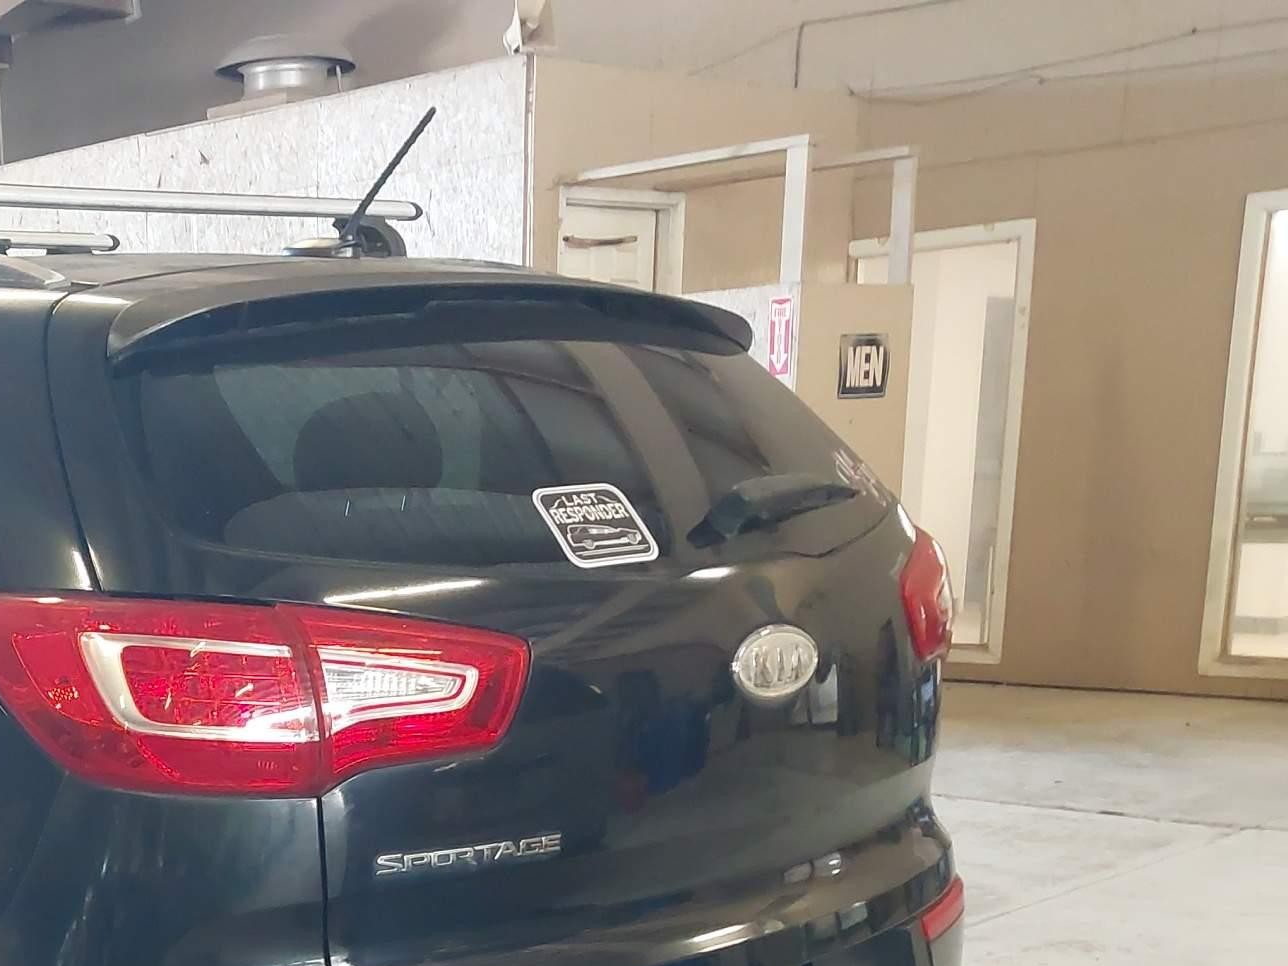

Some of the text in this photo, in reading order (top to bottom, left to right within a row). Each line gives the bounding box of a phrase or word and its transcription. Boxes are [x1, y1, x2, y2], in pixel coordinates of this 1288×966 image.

[845, 344, 885, 388] MEN
[548, 502, 630, 525] RESPONDER
[562, 492, 598, 506] LAST
[752, 643, 807, 688] KIA
[375, 832, 562, 876] SPORTAGE
